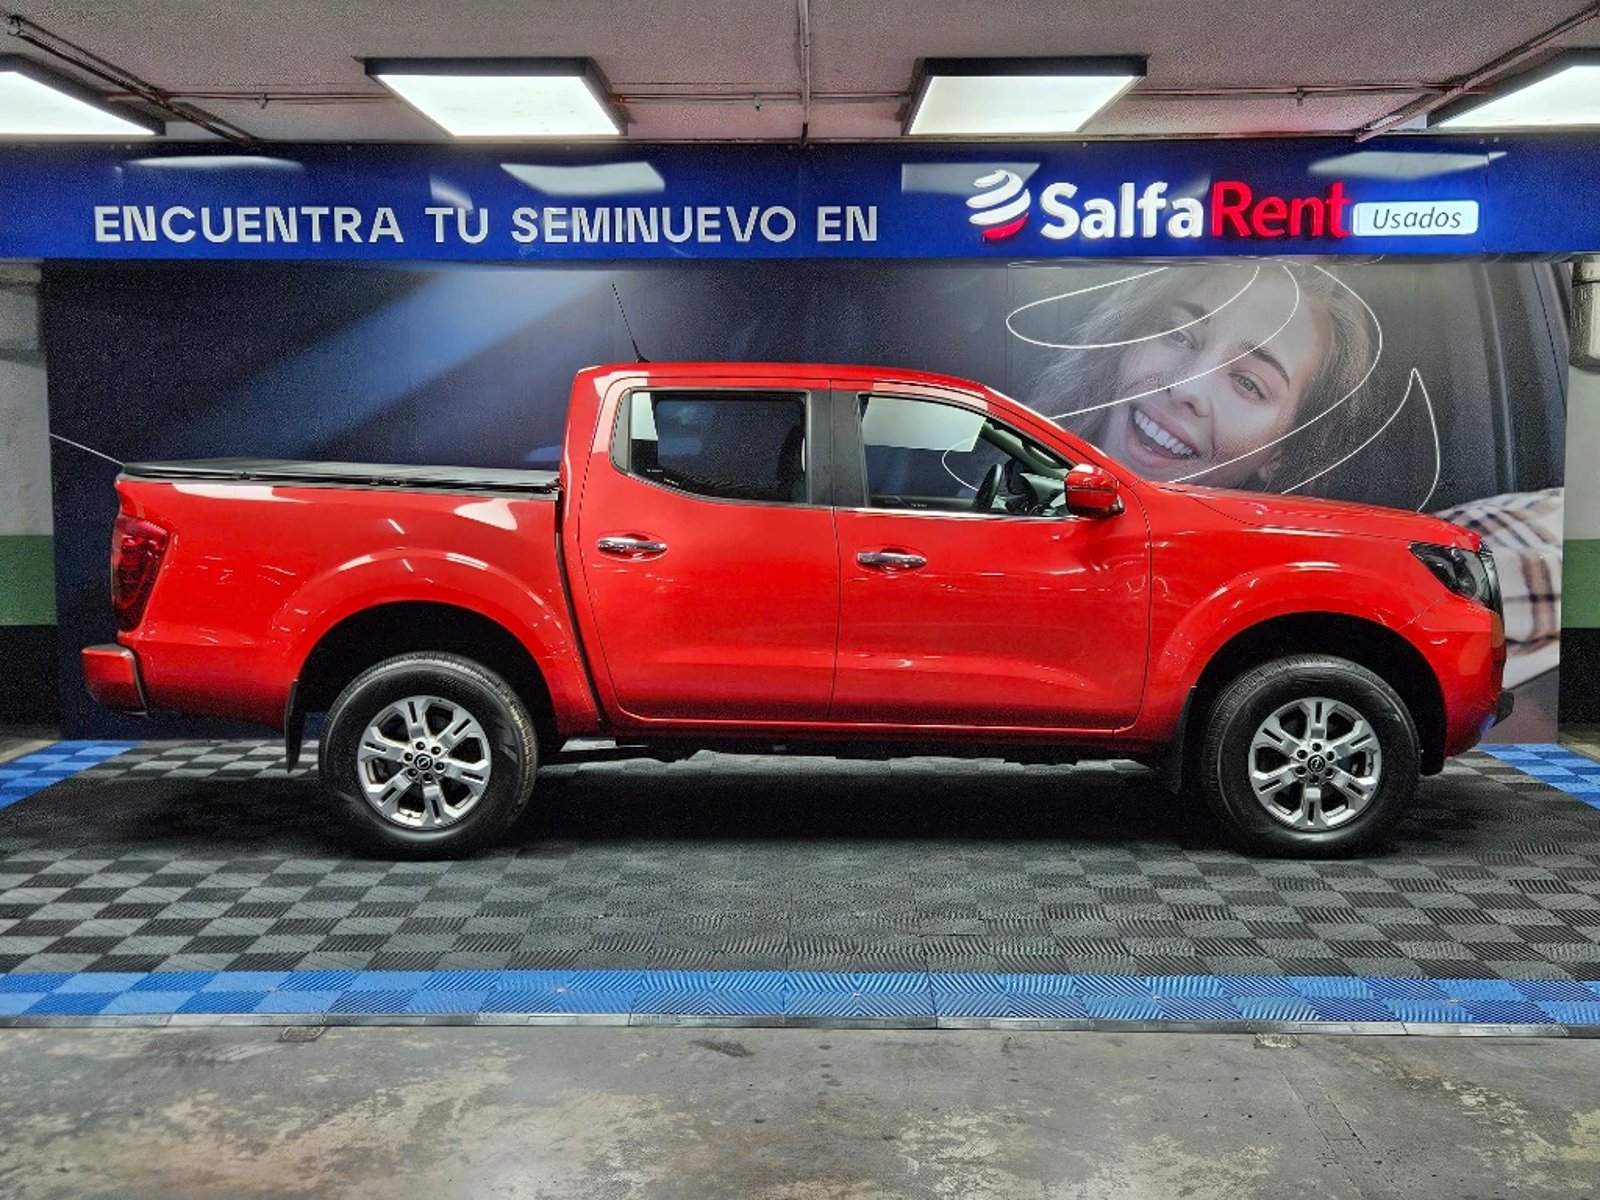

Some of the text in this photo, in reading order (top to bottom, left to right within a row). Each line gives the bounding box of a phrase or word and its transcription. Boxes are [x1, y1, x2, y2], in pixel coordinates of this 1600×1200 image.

[94, 206, 877, 243] ENCUENTRA TU SEMINUEVO EN
[1040, 181, 1350, 239] SalfaRent
[1373, 208, 1462, 229] Usados
